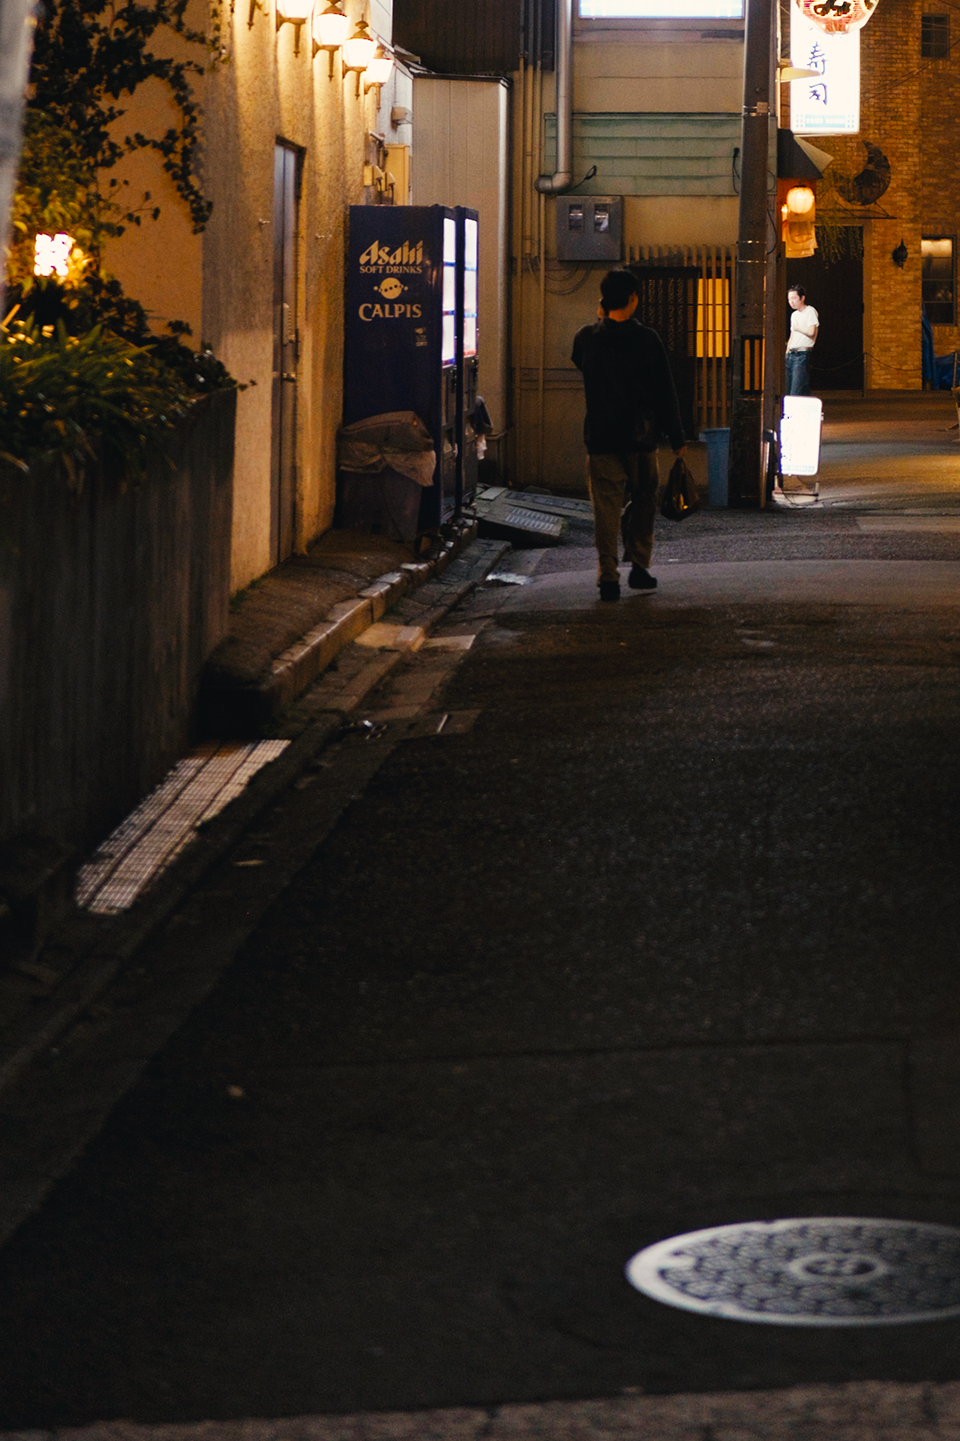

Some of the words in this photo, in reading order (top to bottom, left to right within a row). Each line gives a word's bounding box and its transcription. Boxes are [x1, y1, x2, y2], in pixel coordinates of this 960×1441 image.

[359, 240, 423, 265] Asahi
[360, 265, 383, 274] SOFT
[386, 265, 423, 274] DRINKS
[358, 303, 422, 321] CALPIS
